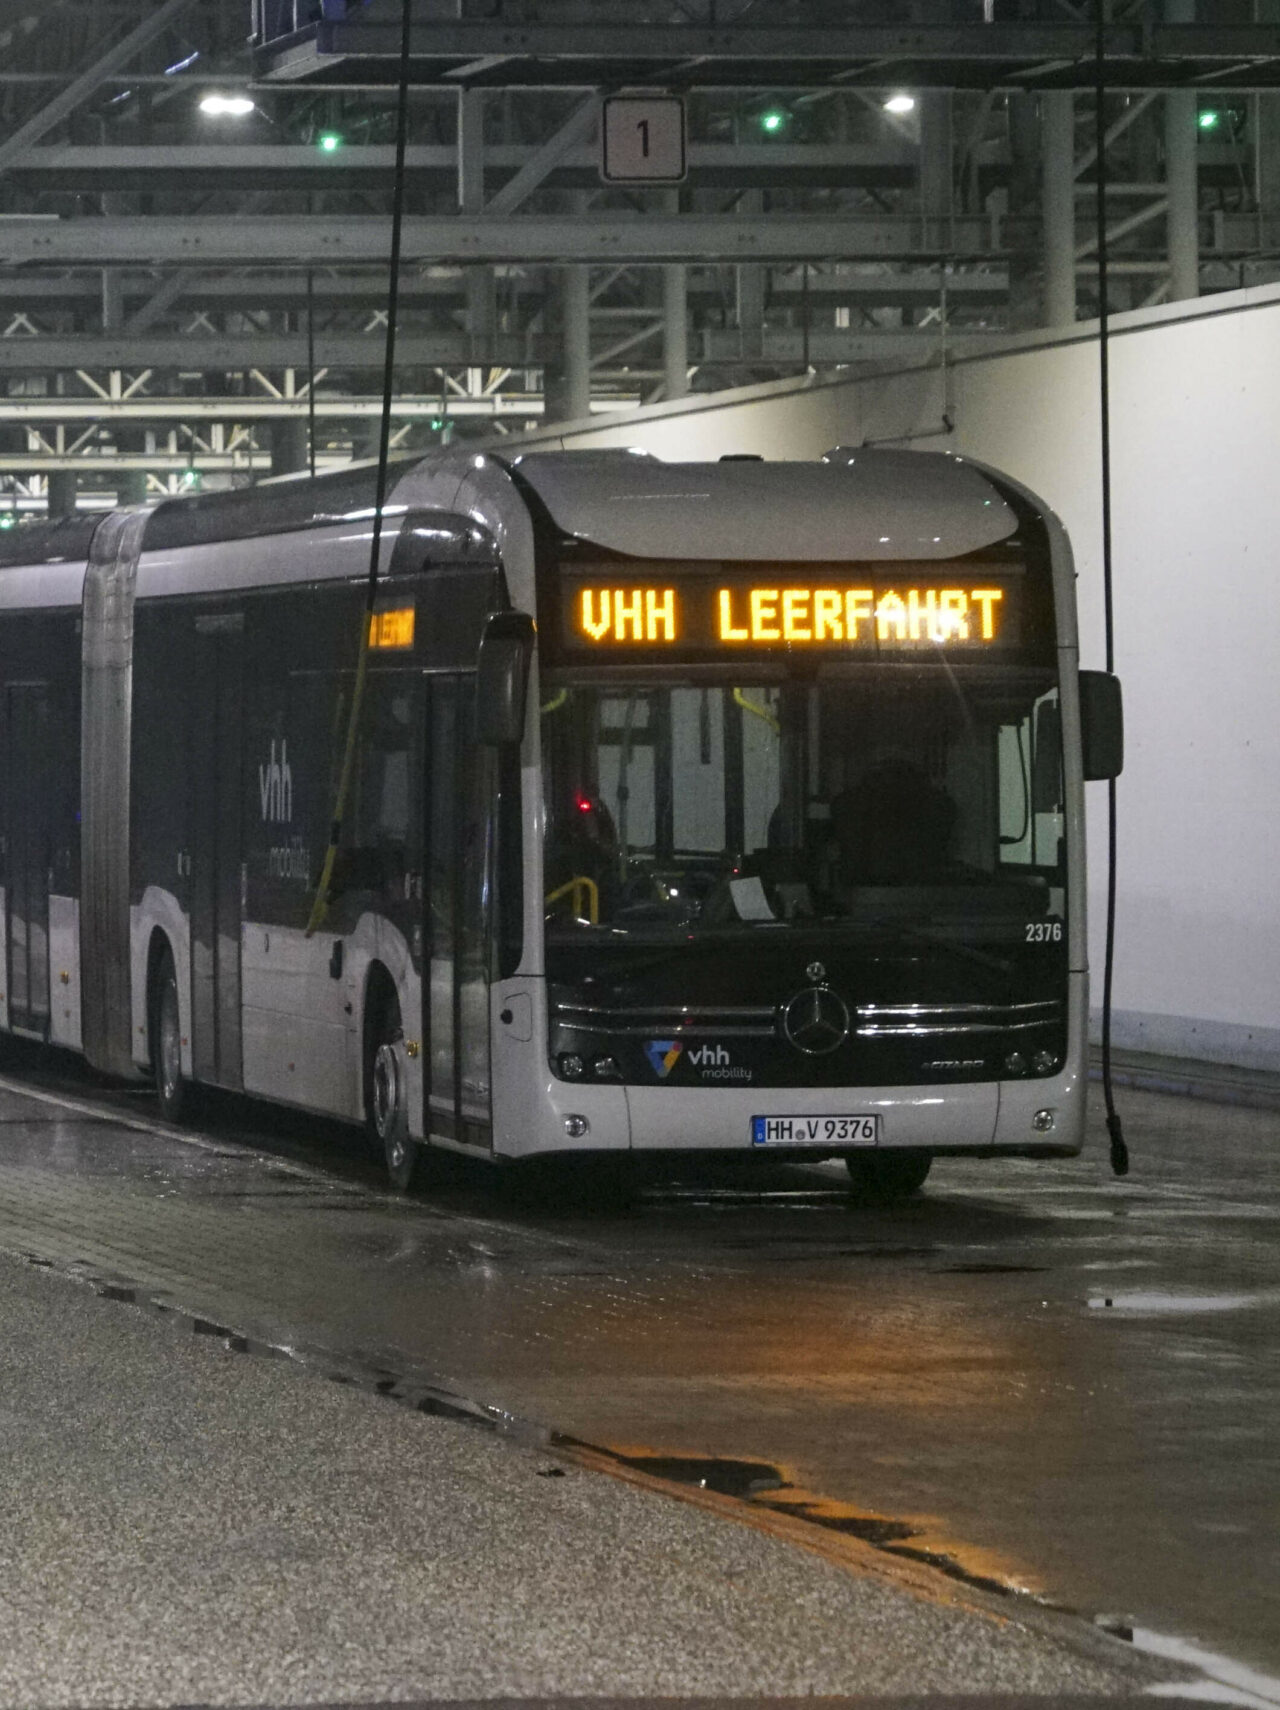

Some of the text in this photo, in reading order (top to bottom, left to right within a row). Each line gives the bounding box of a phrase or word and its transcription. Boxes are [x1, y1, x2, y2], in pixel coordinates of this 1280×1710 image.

[636, 119, 649, 157] 1
[581, 589, 1003, 641] VHH LEERFAHRT
[259, 738, 292, 822] vhh
[1025, 922, 1062, 942] 2376
[686, 1044, 730, 1066] vhh
[701, 1066, 753, 1081] mobility
[767, 1119, 874, 1140] HH V 9376
